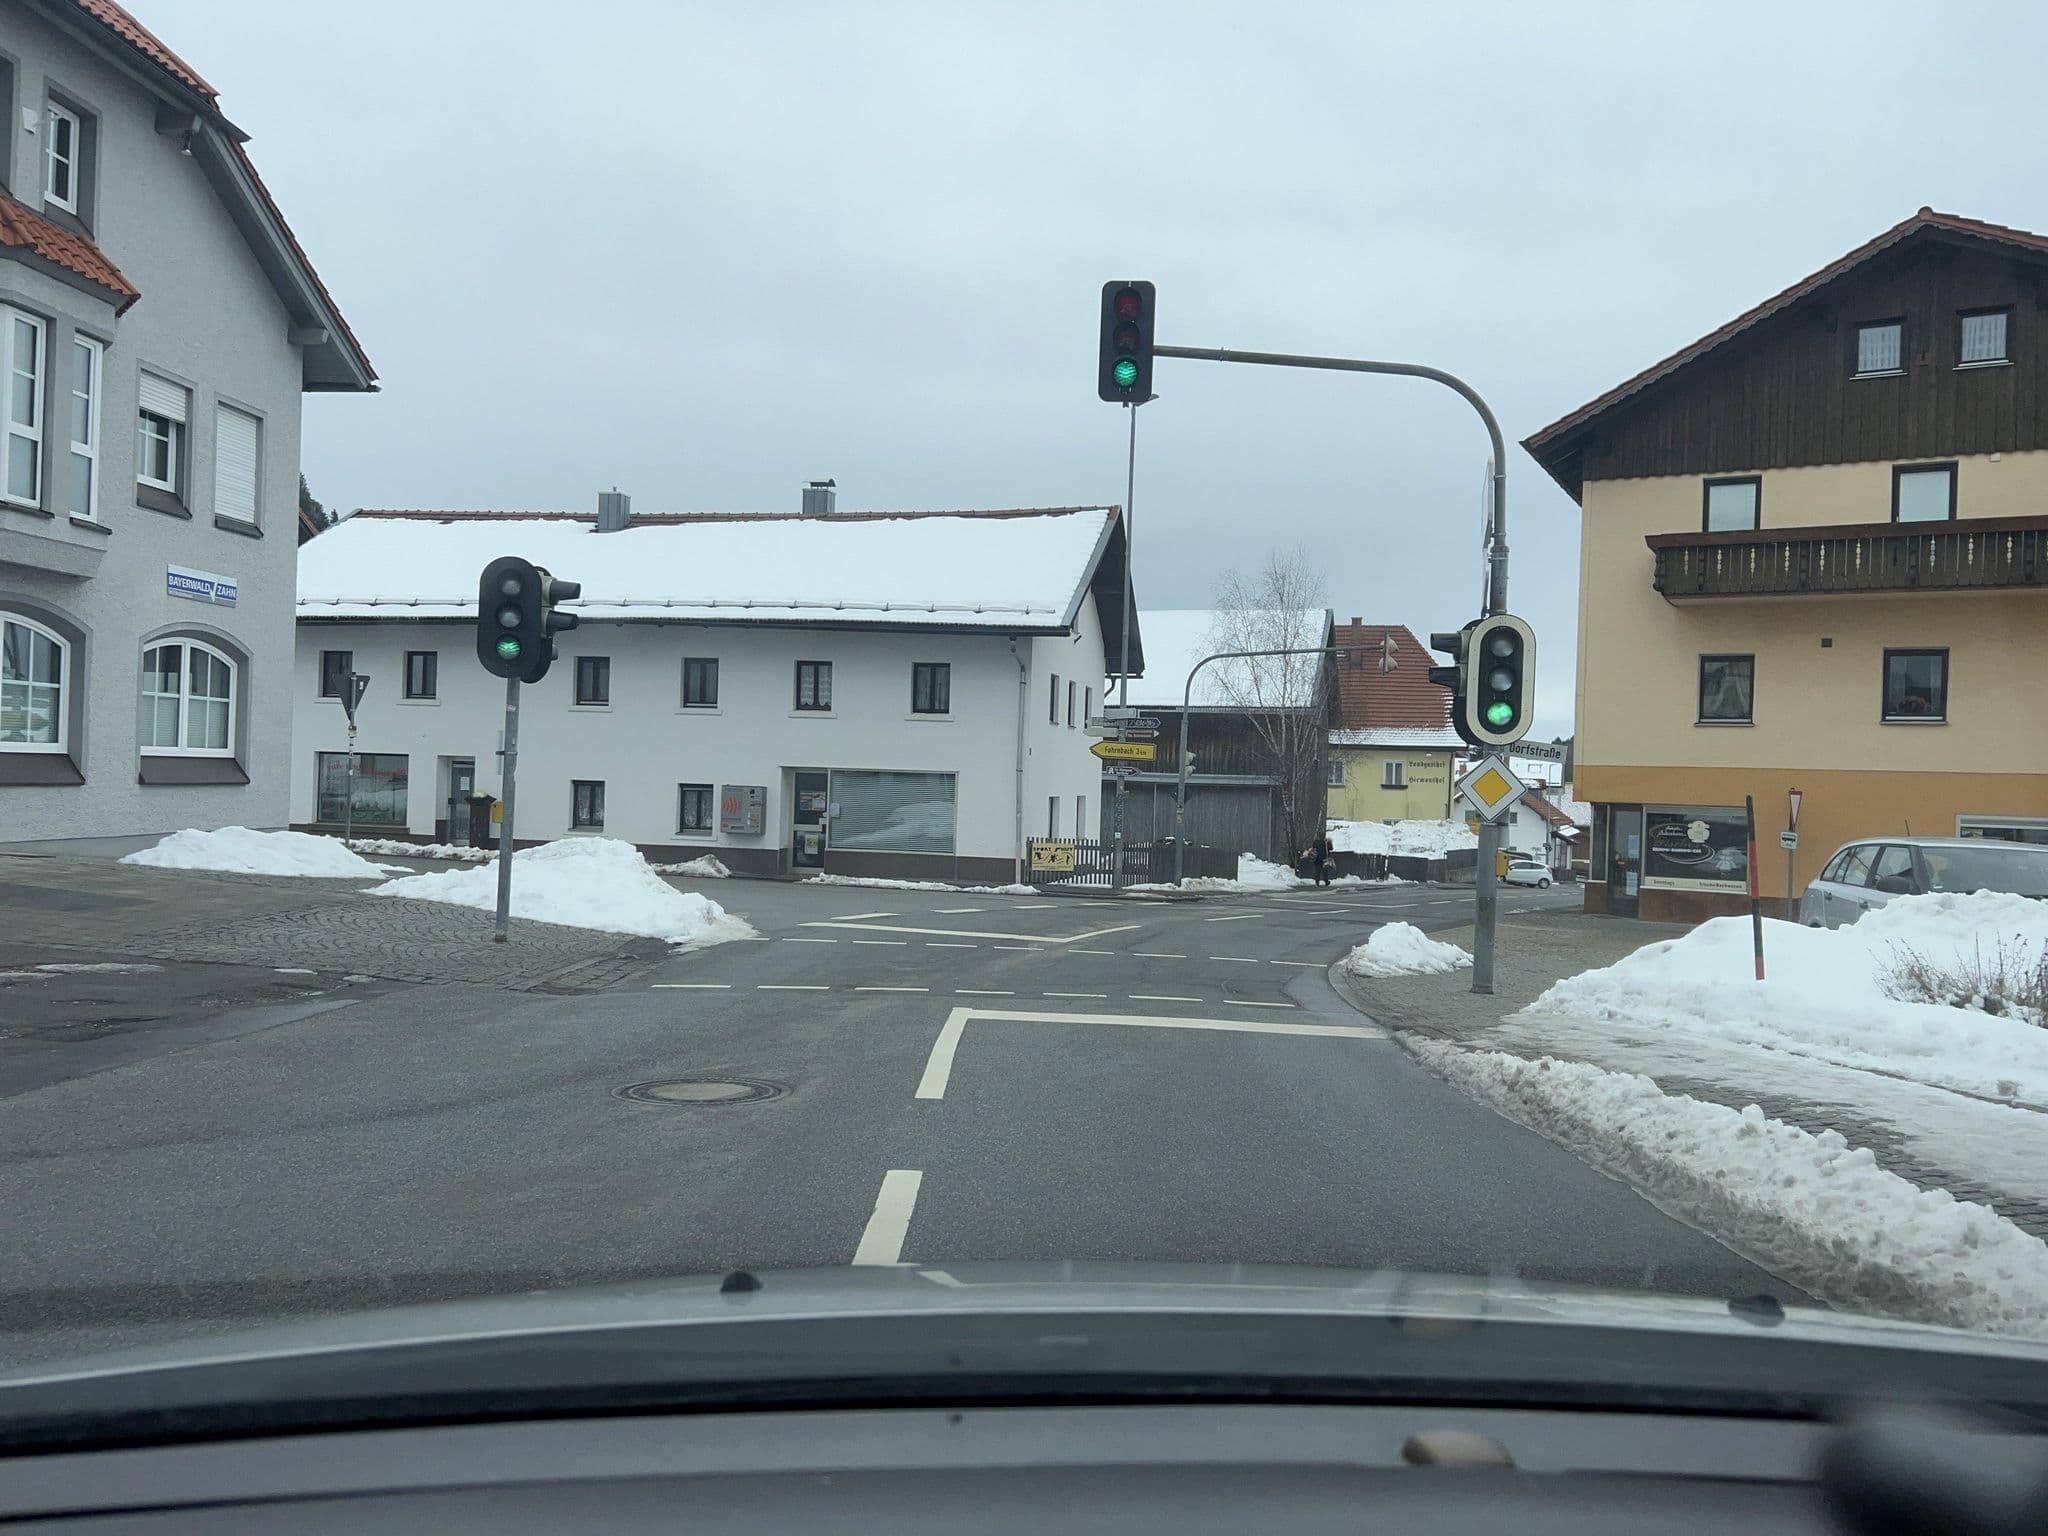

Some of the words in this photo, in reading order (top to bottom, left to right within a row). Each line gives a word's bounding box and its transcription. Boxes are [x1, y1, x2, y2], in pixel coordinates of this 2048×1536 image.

[168, 575, 211, 592] BAYERWALD
[217, 585, 236, 598] ZAHN
[1104, 745, 1134, 755] Fahrnbach
[1509, 742, 1561, 759] Dorfstraße
